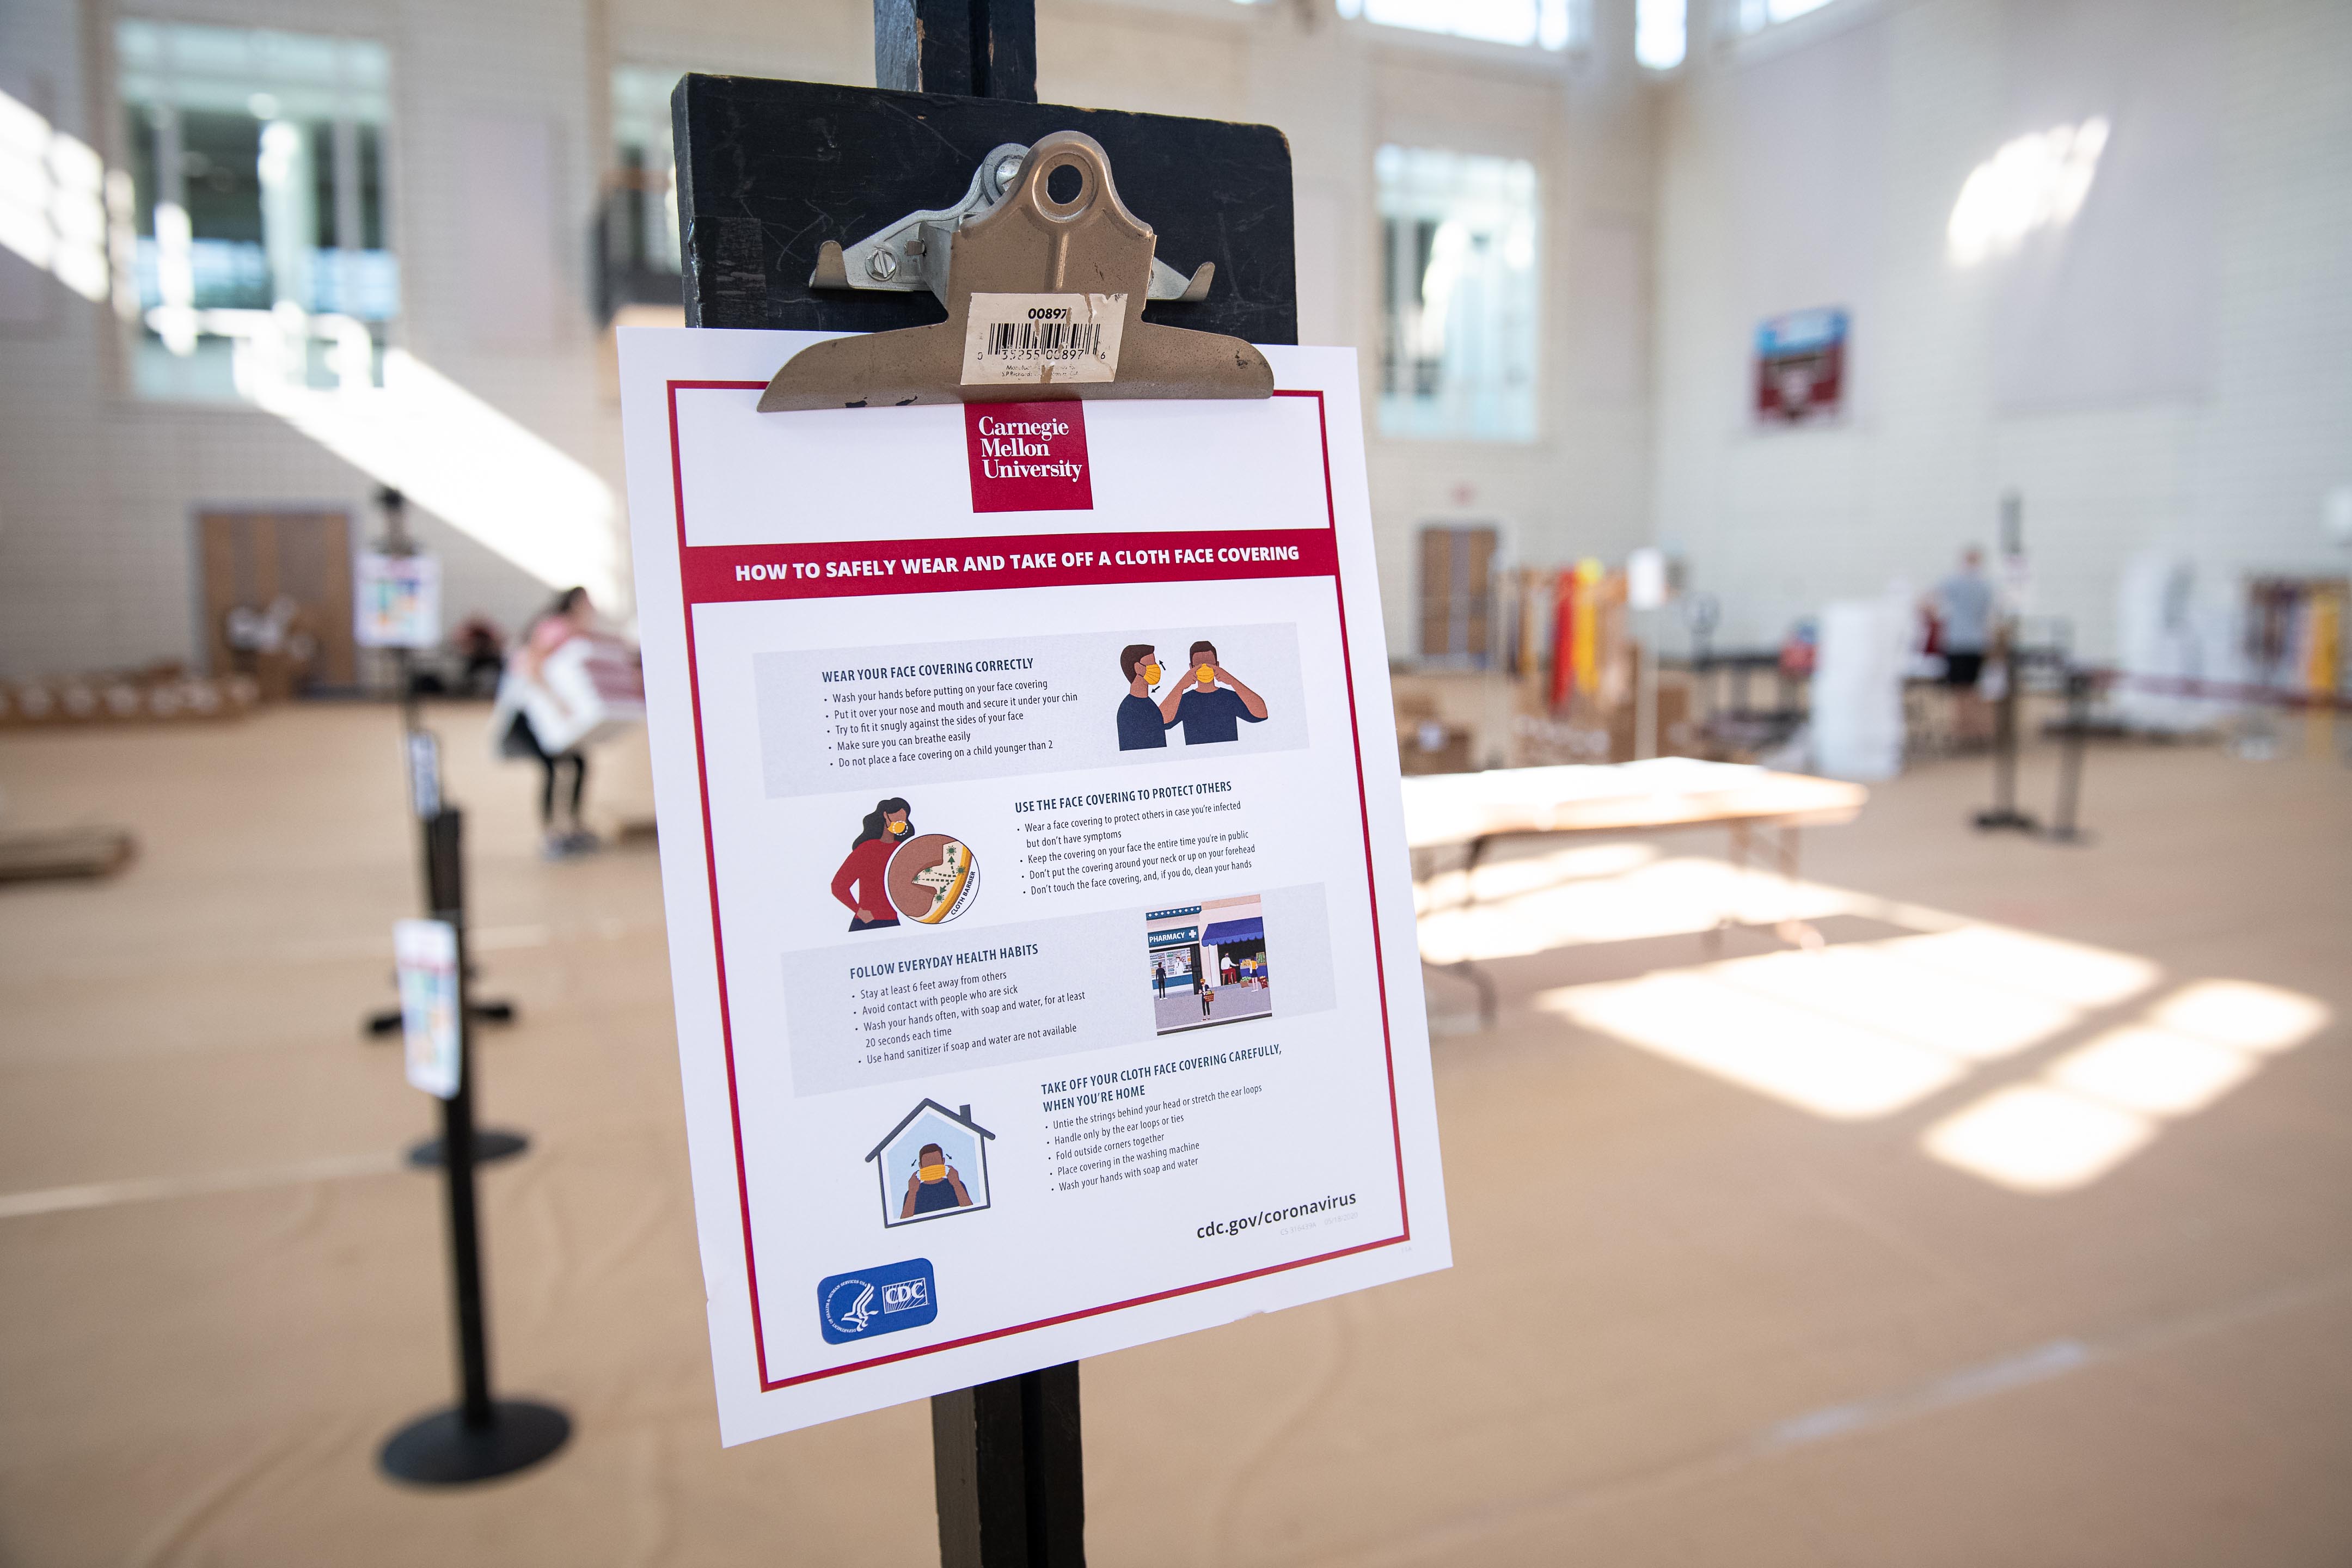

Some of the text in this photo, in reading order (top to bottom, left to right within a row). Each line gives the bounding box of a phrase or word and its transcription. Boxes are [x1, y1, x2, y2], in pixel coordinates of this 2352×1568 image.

[1028, 308, 1068, 319] 00897
[979, 416, 1069, 440] Carnegie
[980, 438, 1050, 457] Mellon
[982, 460, 1082, 482] University
[736, 546, 1298, 581] HOW TO SAFELY WEAR AND TAKE OFF A CLOTH FACE COVERING
[821, 658, 1033, 683] WEAR YOUR FACE COVERING CORRECTLY
[832, 679, 1048, 704] Wash your hands before putting on your face covering
[835, 711, 1024, 737] Try to fit it snugly against the sides of your face
[837, 731, 971, 751] Make sure you can breathe easily
[1015, 781, 1232, 813] USE THE FACE COVERING TO PROTECT OTHERS
[1024, 823, 1045, 832] Wear
[1053, 820, 1069, 830] face
[1071, 817, 1102, 828] covering
[1104, 816, 1112, 824] to
[1114, 812, 1141, 825] protect
[1142, 810, 1165, 820] others
[1166, 808, 1173, 817] in
[1174, 808, 1190, 816] case
[1213, 800, 1241, 812] infected
[1026, 838, 1040, 848] but
[1063, 835, 1081, 844] have
[1083, 831, 1122, 844] symptoms
[1053, 881, 1075, 892] touch
[1076, 880, 1089, 890] the
[1091, 878, 1107, 888] face
[1108, 874, 1142, 886] covering,
[1143, 871, 1159, 881] and,
[1160, 869, 1166, 879] if
[1167, 870, 1180, 880] you
[1182, 867, 1193, 877] do,
[1195, 865, 1213, 875] clean
[1214, 863, 1230, 874] your
[1231, 859, 1252, 870] hands
[951, 871, 976, 915] CLOTH BARRIER
[1149, 932, 1185, 943] PHARMACY
[850, 944, 1038, 979] FOLLOW EVERYDAY HEALTH HABITS
[860, 971, 1007, 1000] Stay at least 6 feet away from others
[862, 984, 1018, 1015] Avoid contact with people who are sick
[865, 1028, 952, 1048] 20 seconds each time
[1040, 1043, 1282, 1095] TAKE OFF YOUR CLOTH FACE COVERING CAREFULLY,
[1042, 1097, 1075, 1113] WHEN
[1116, 1085, 1146, 1100] HOME
[1055, 1115, 1184, 1145] Handle only by the ear loops or ties
[1056, 1133, 1165, 1161] Fold outside corners together
[1057, 1142, 1199, 1176] Place covering in the washing machine
[1197, 1193, 1356, 1239] cdc.gov/coronavirus
[885, 1282, 924, 1304] CDC
